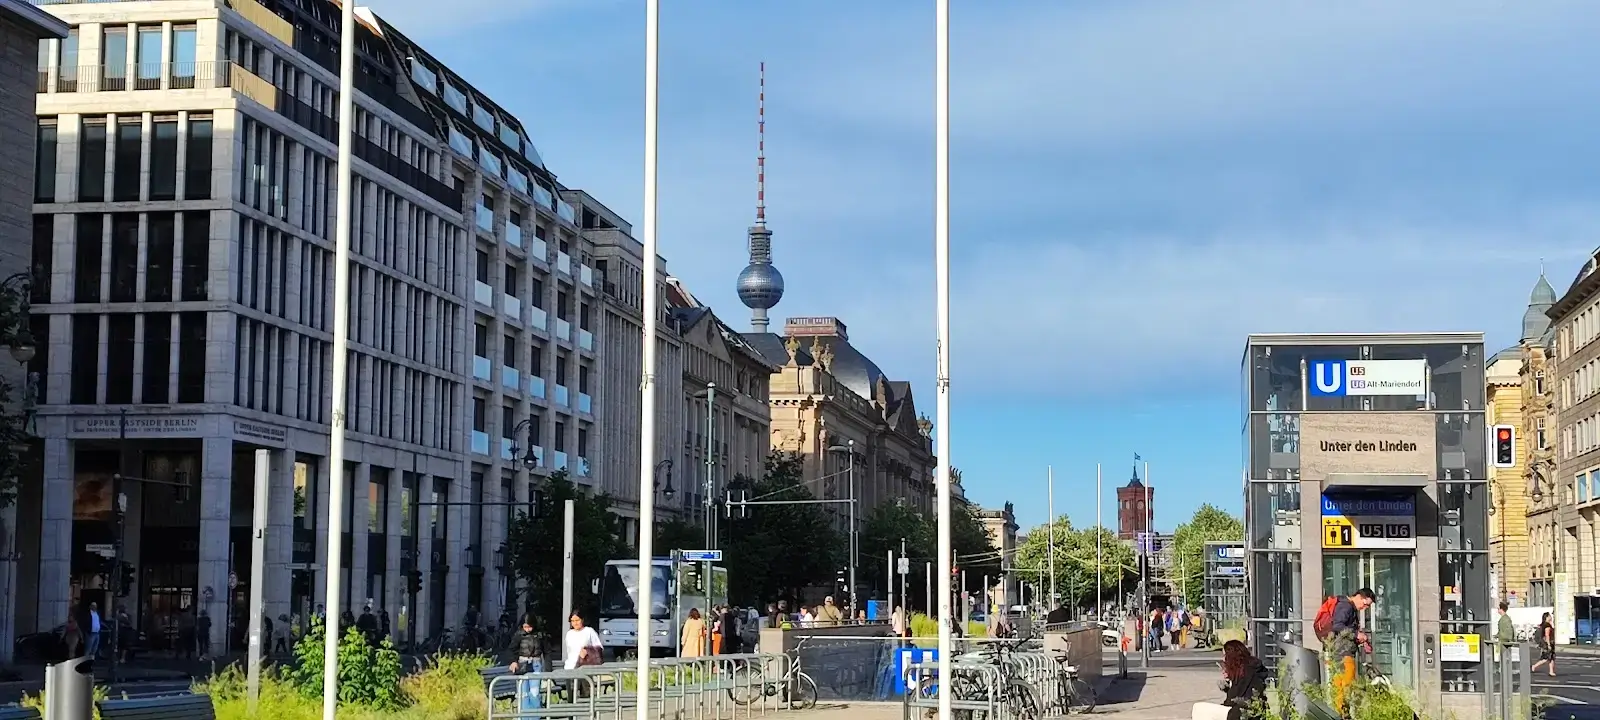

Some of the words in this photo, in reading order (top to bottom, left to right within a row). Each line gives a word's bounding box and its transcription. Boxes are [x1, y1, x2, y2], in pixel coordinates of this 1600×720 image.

[1351, 367, 1365, 375] U5
[1316, 363, 1341, 393] U
[1351, 380, 1365, 388] U6
[1367, 380, 1421, 388] Alt-Mariendorf
[86, 419, 115, 427] UPPER
[164, 419, 198, 427] BERLIN
[1320, 440, 1352, 452] Unter
[1354, 440, 1376, 452] den
[1379, 440, 1417, 452] Linden
[1324, 500, 1353, 511] Unter
[1356, 500, 1375, 511] den
[1378, 500, 1412, 511] Linden
[1342, 528, 1349, 542] 1
[1362, 525, 1382, 537] U5
[1388, 525, 1409, 537] U6
[1218, 547, 1226, 557] U
